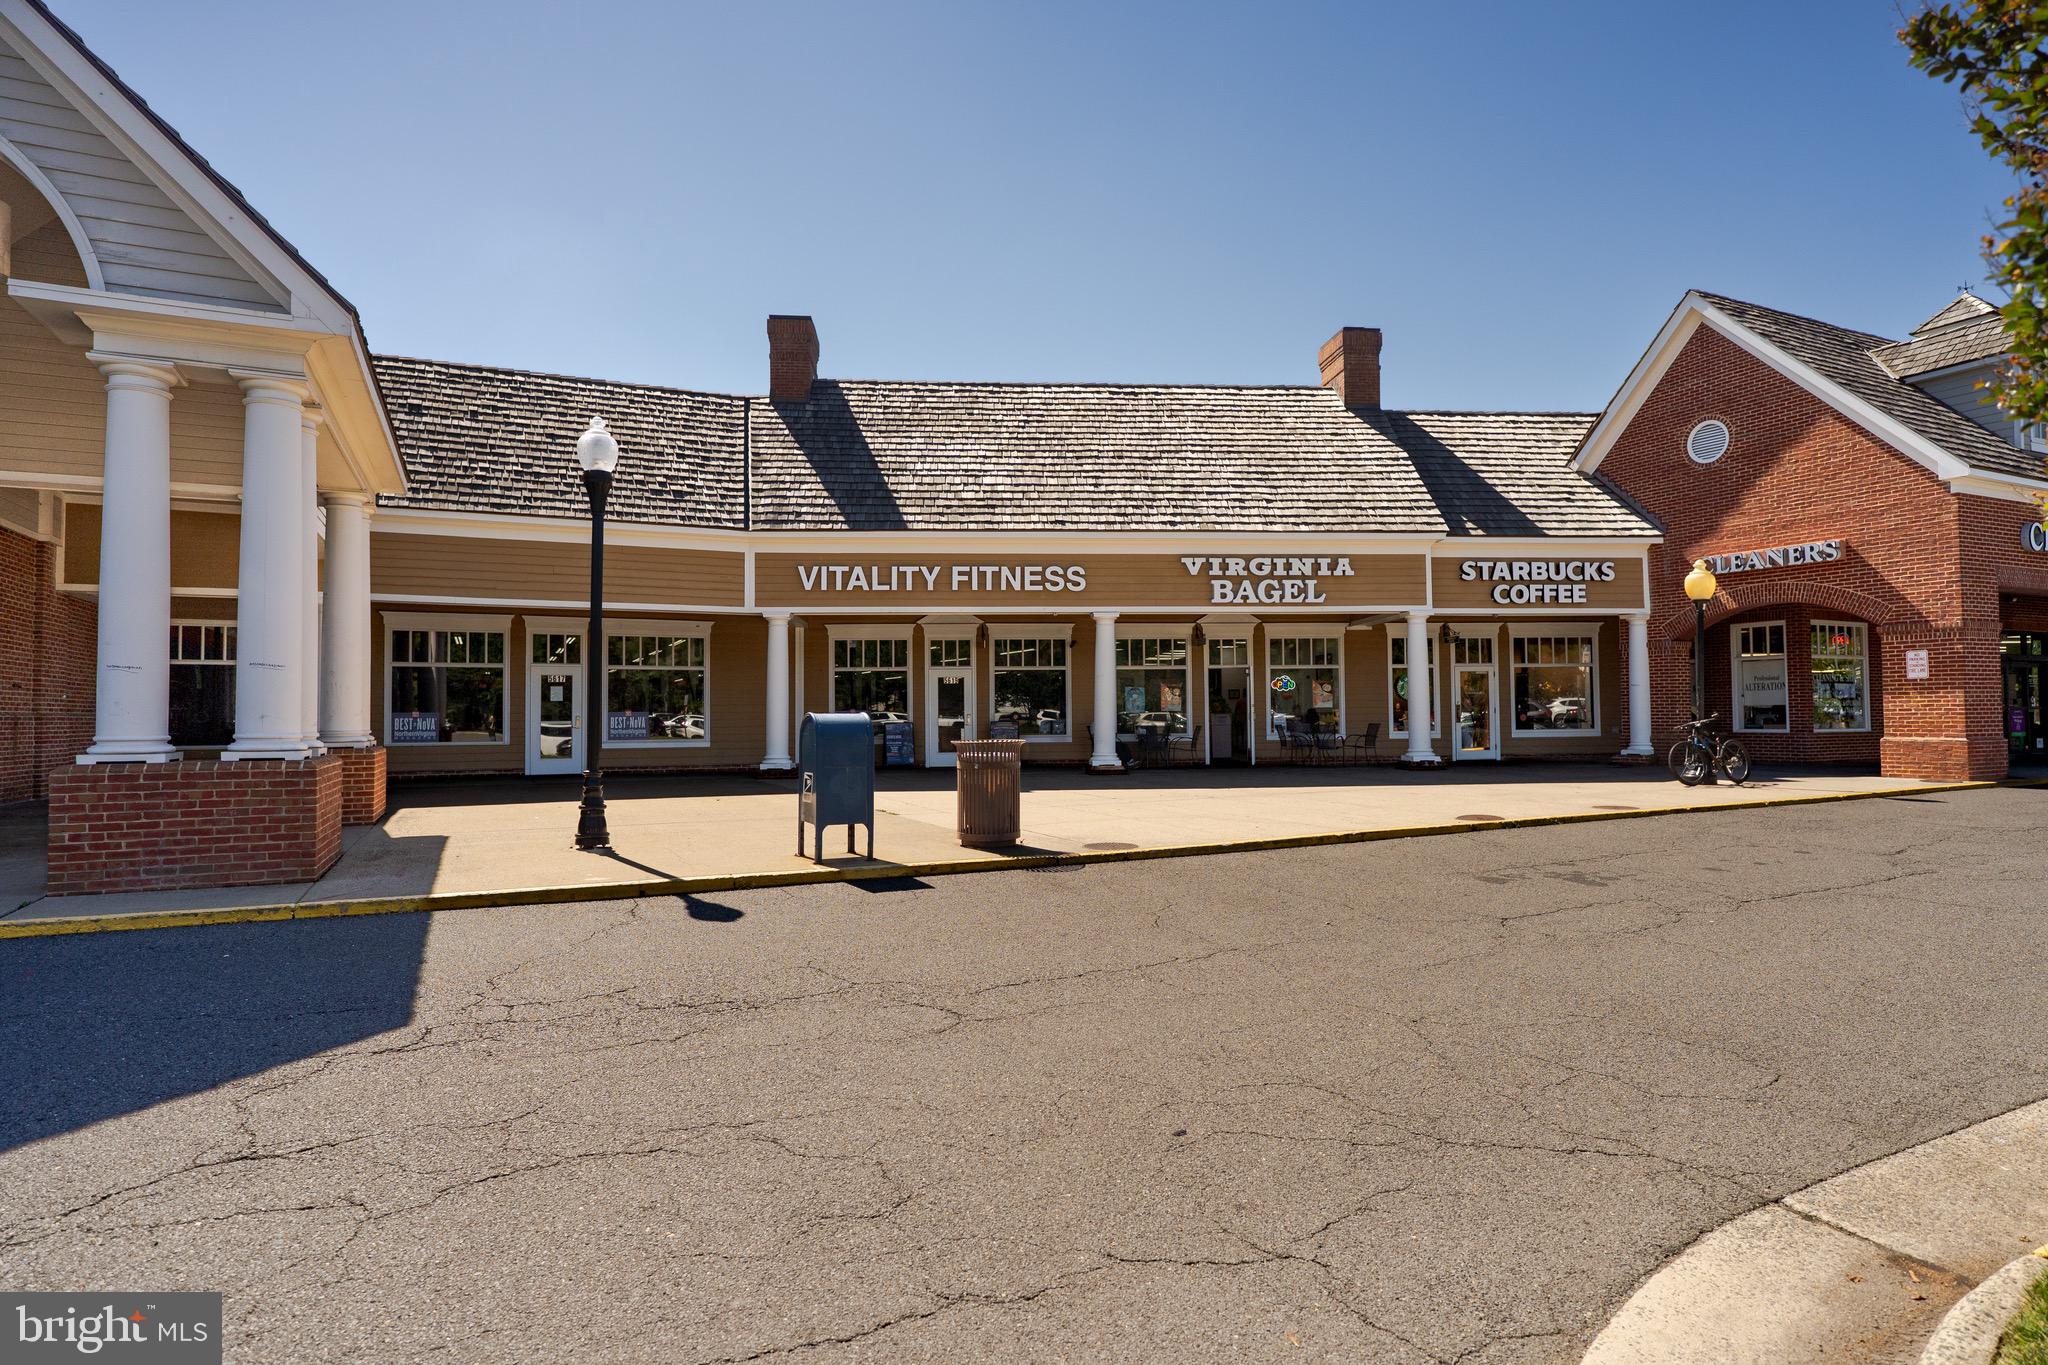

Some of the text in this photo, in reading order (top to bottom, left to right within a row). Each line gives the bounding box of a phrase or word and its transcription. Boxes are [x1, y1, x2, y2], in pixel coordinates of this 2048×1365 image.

[2029, 521, 2048, 552] C
[1181, 557, 1355, 577] VIRGINIA
[1461, 561, 1616, 582] STARBUCKS
[797, 565, 1087, 592] VITALITY FITNESS
[1211, 579, 1327, 604] BAGEL
[1492, 584, 1587, 604] COFFEE
[394, 718, 413, 730] BEST
[610, 717, 627, 728] BEST
